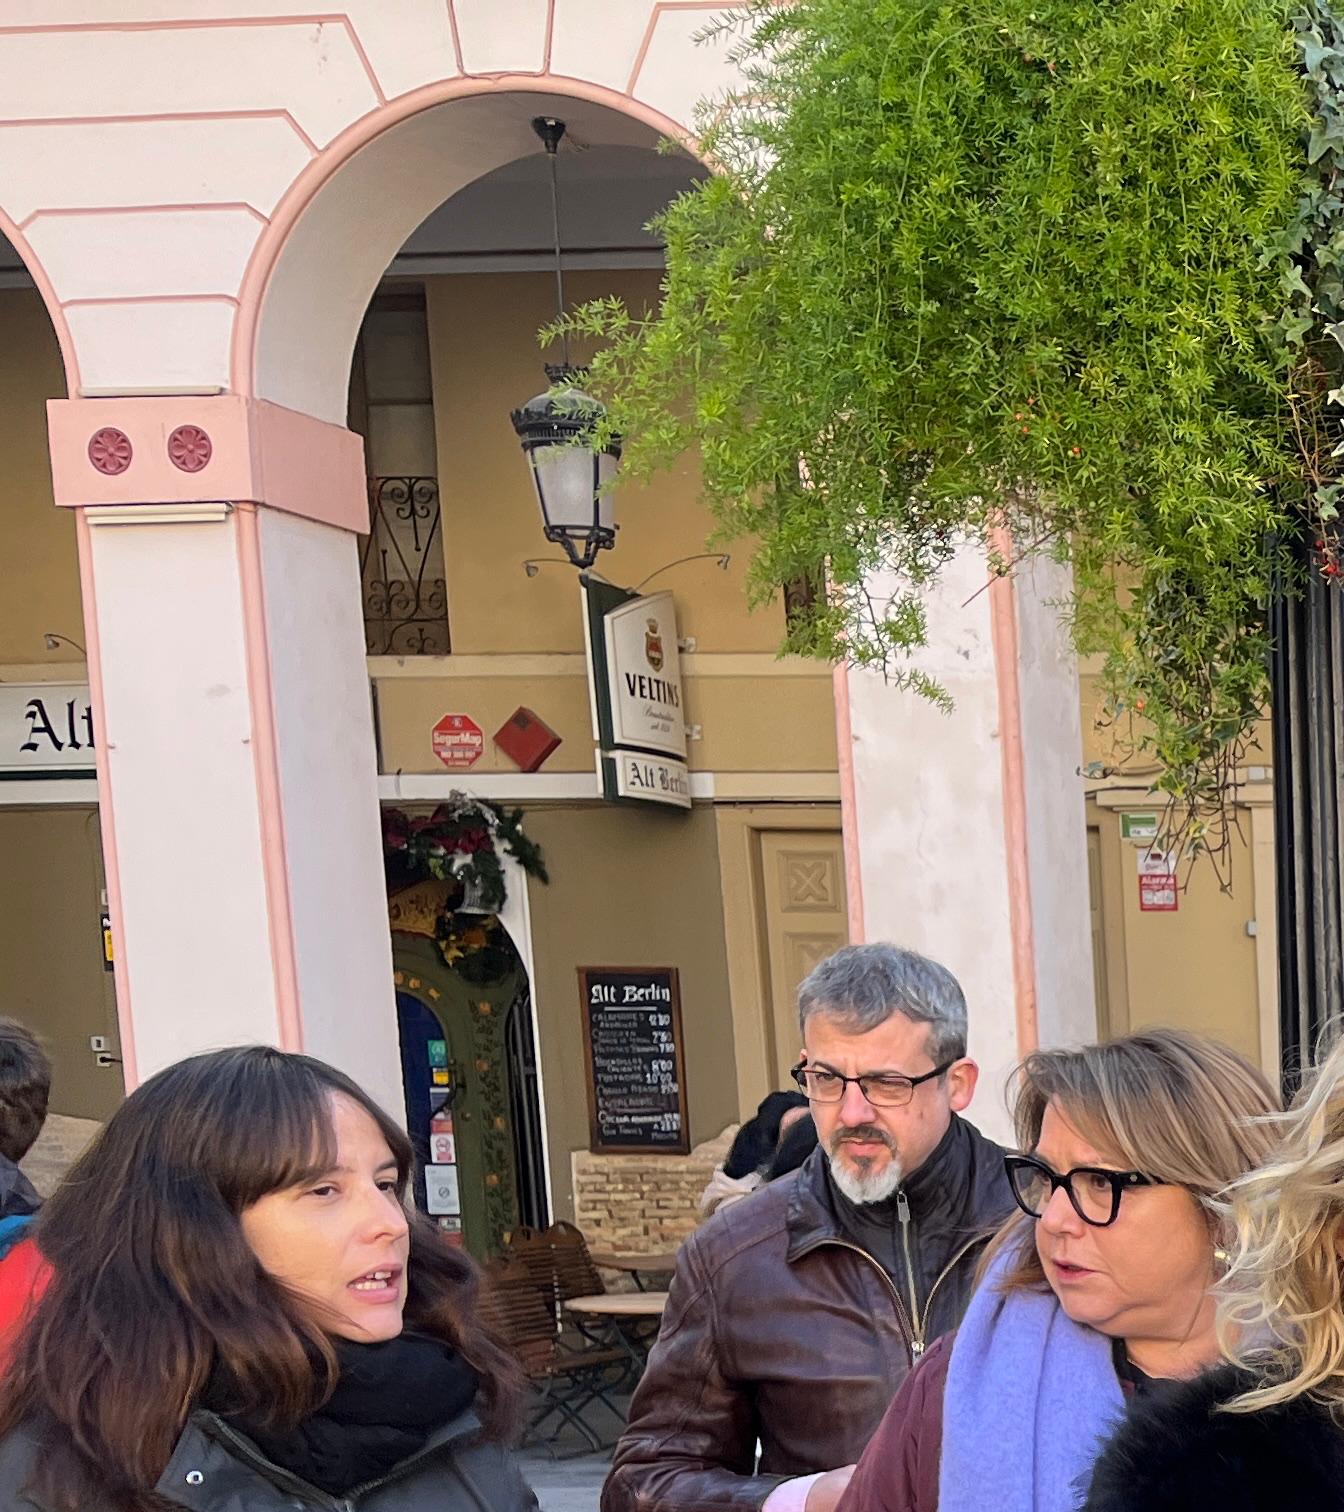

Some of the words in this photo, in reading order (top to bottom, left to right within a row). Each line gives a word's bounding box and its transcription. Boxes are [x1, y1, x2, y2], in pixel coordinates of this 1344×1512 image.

[624, 672, 680, 708] VELTINS
[20, 698, 95, 752] Alt
[629, 762, 655, 790] Alt
[658, 767, 689, 795] Berlin
[590, 984, 617, 1004] Alt
[622, 983, 671, 1004] Berlin
